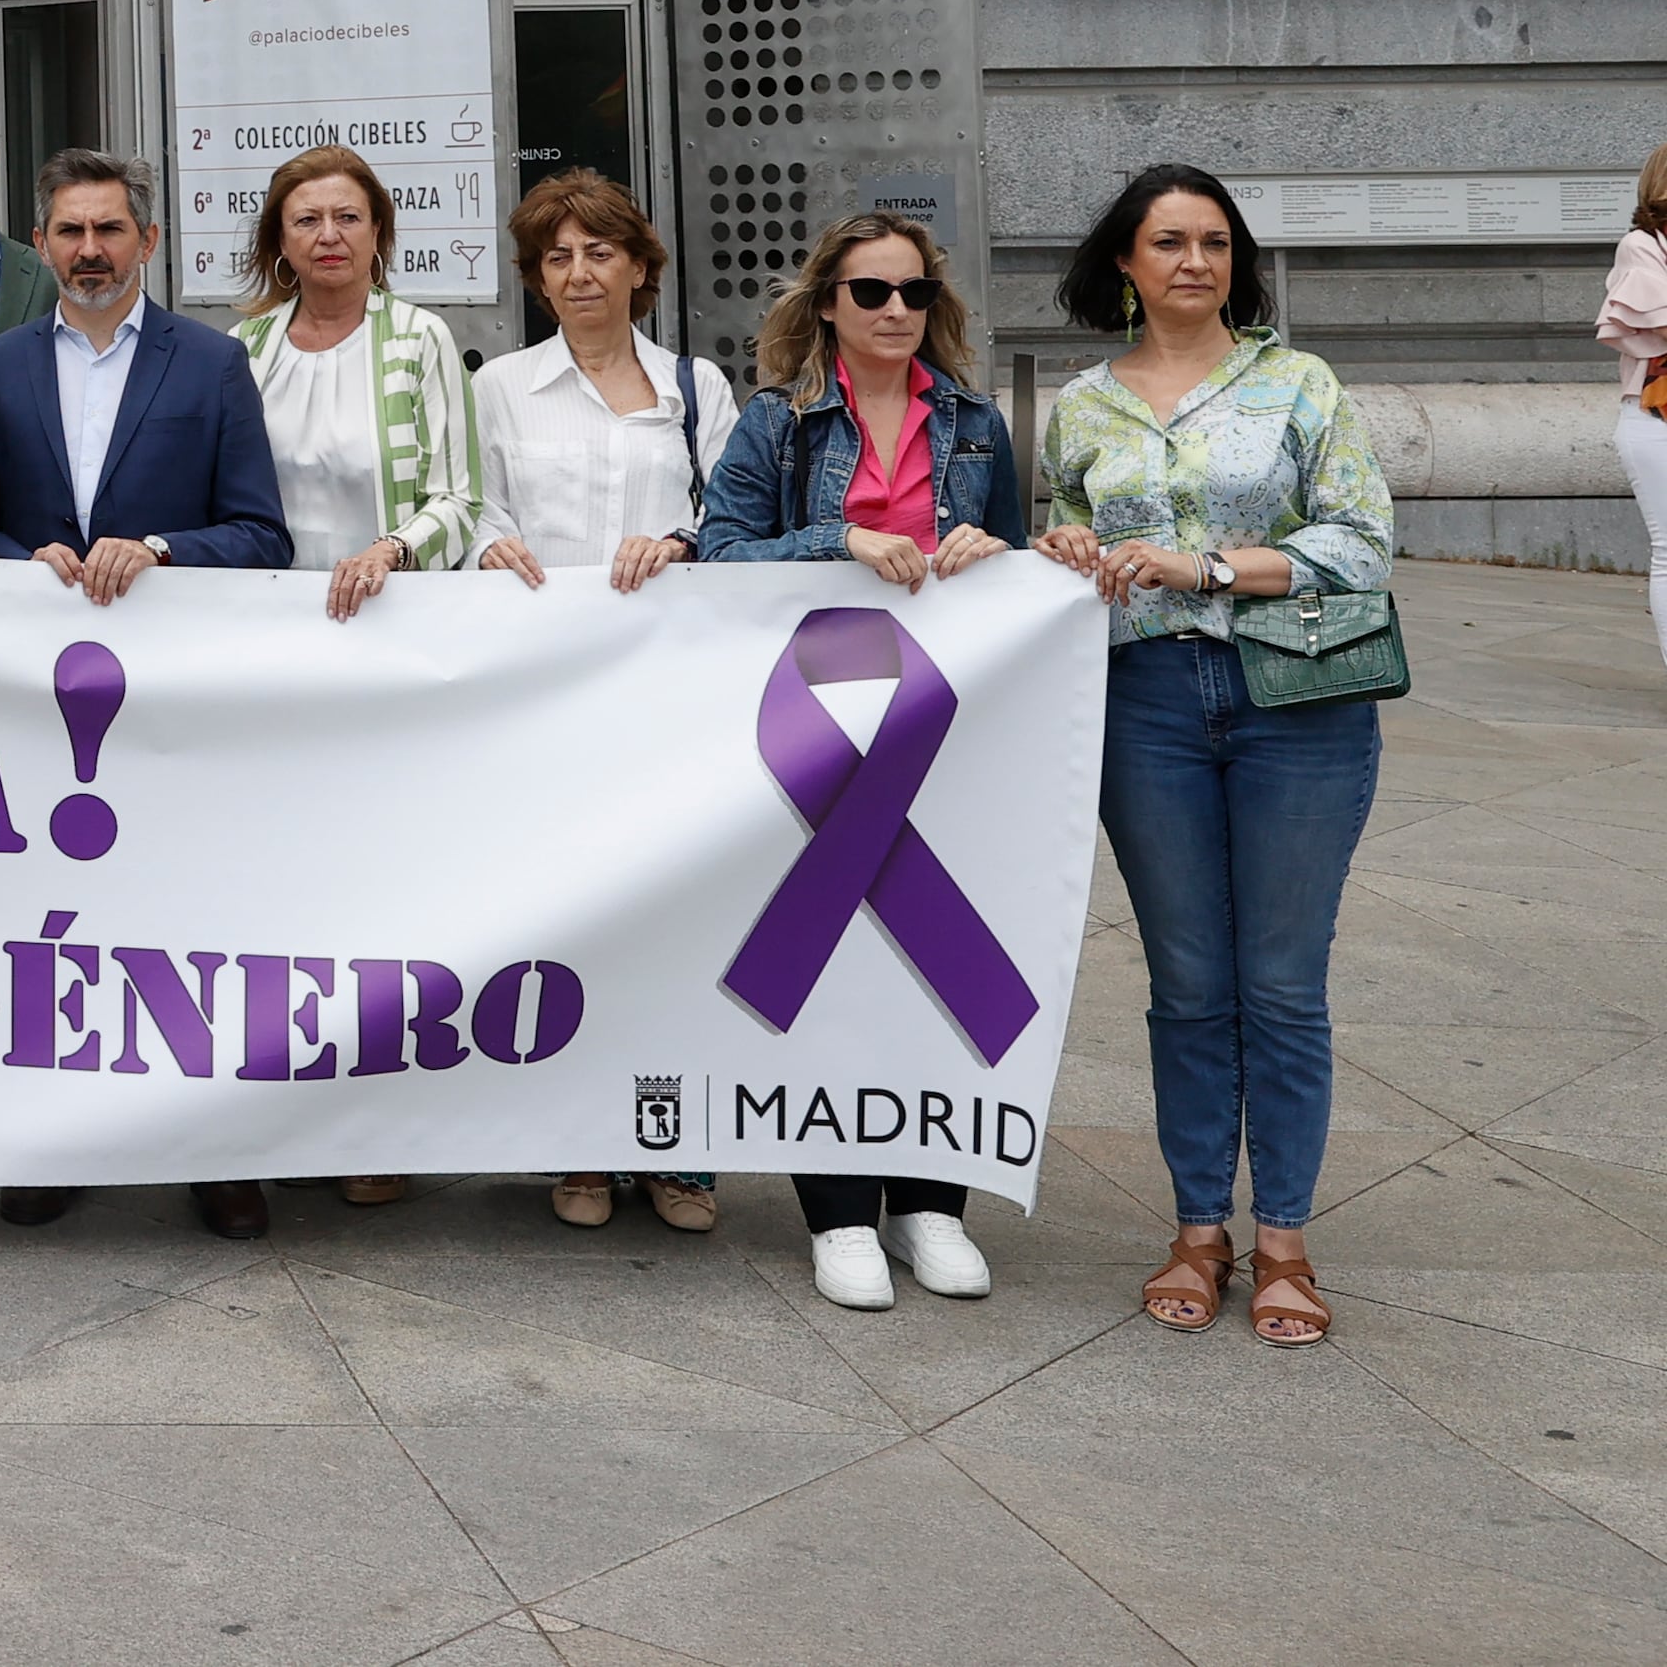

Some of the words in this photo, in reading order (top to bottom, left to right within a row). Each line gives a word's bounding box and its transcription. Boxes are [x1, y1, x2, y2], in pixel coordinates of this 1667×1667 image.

[248, 22, 410, 47] @palaciodecibeles
[235, 119, 339, 150] COLECCIÓN
[349, 121, 427, 145] CIBELES
[874, 198, 938, 209] ENTRADA
[405, 249, 440, 272] BAR
[734, 1083, 1038, 1168] MADRID
